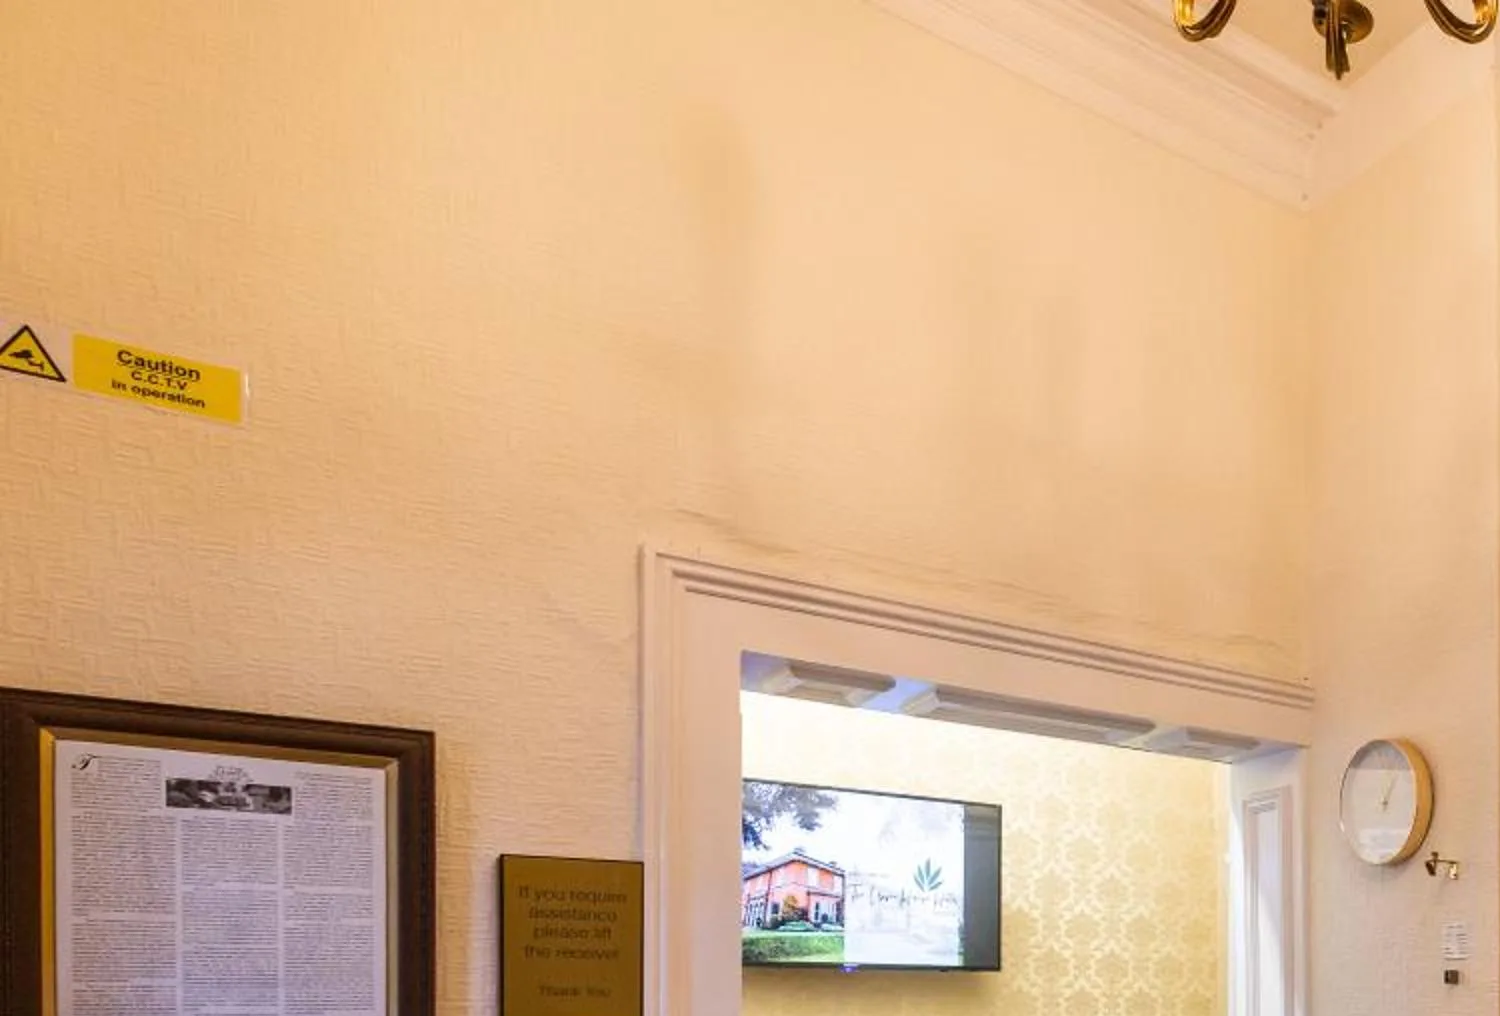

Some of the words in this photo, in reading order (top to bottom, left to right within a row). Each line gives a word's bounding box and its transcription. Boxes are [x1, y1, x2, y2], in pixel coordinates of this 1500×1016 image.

[117, 350, 200, 382] Caution
[131, 384, 206, 409] operation
[518, 886, 530, 900] If
[533, 889, 565, 904] you
